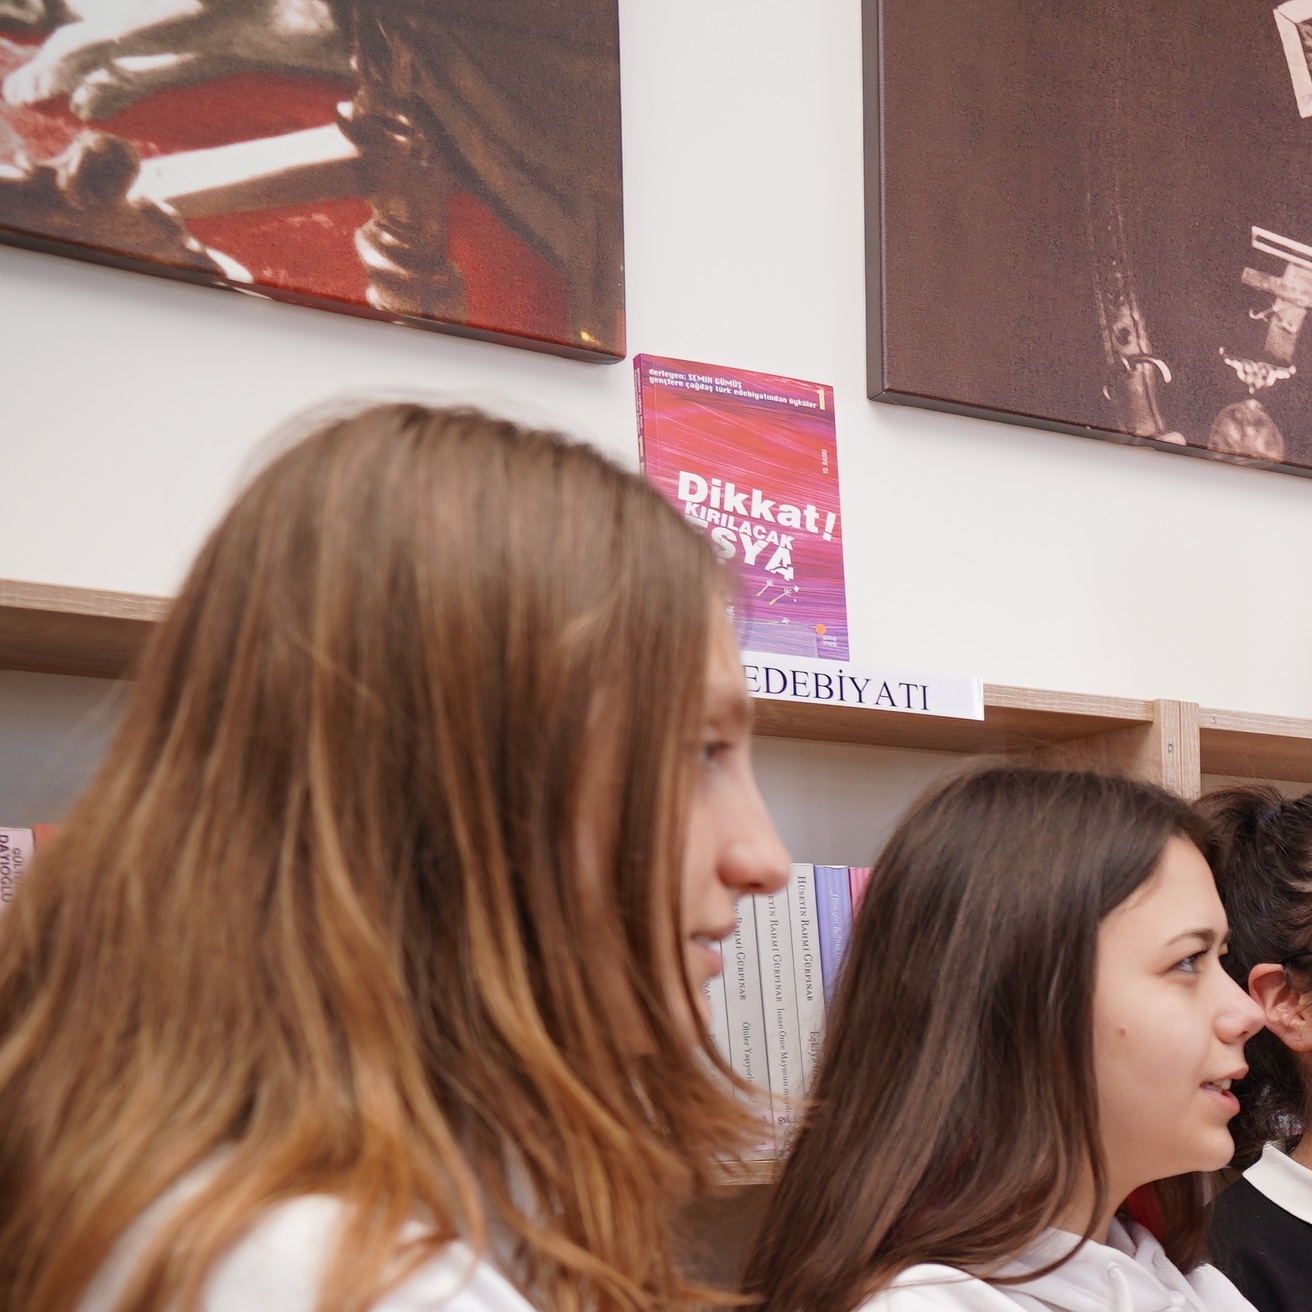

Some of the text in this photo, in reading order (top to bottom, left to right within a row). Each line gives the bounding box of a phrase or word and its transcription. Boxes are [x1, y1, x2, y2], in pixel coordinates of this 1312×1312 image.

[649, 376, 817, 409] gençlere çağdaş türk edebiyatından öyküler
[714, 377, 743, 390] GÜMÜŞ
[678, 470, 837, 541] Dikkat!
[685, 501, 795, 551] KIRILACAK
[769, 919, 781, 951] RAHMİ
[797, 876, 814, 1001] HÜSEYİN RAHMİ GÜRPINAR
[736, 952, 748, 1001] GÜRPINAR
[773, 954, 784, 1002] GÜRPINAR
[742, 1022, 751, 1046] Ölüler
[777, 1008, 786, 1030] İnsan
[778, 1030, 789, 1051] Önce
[780, 1052, 791, 1087] Maymun
